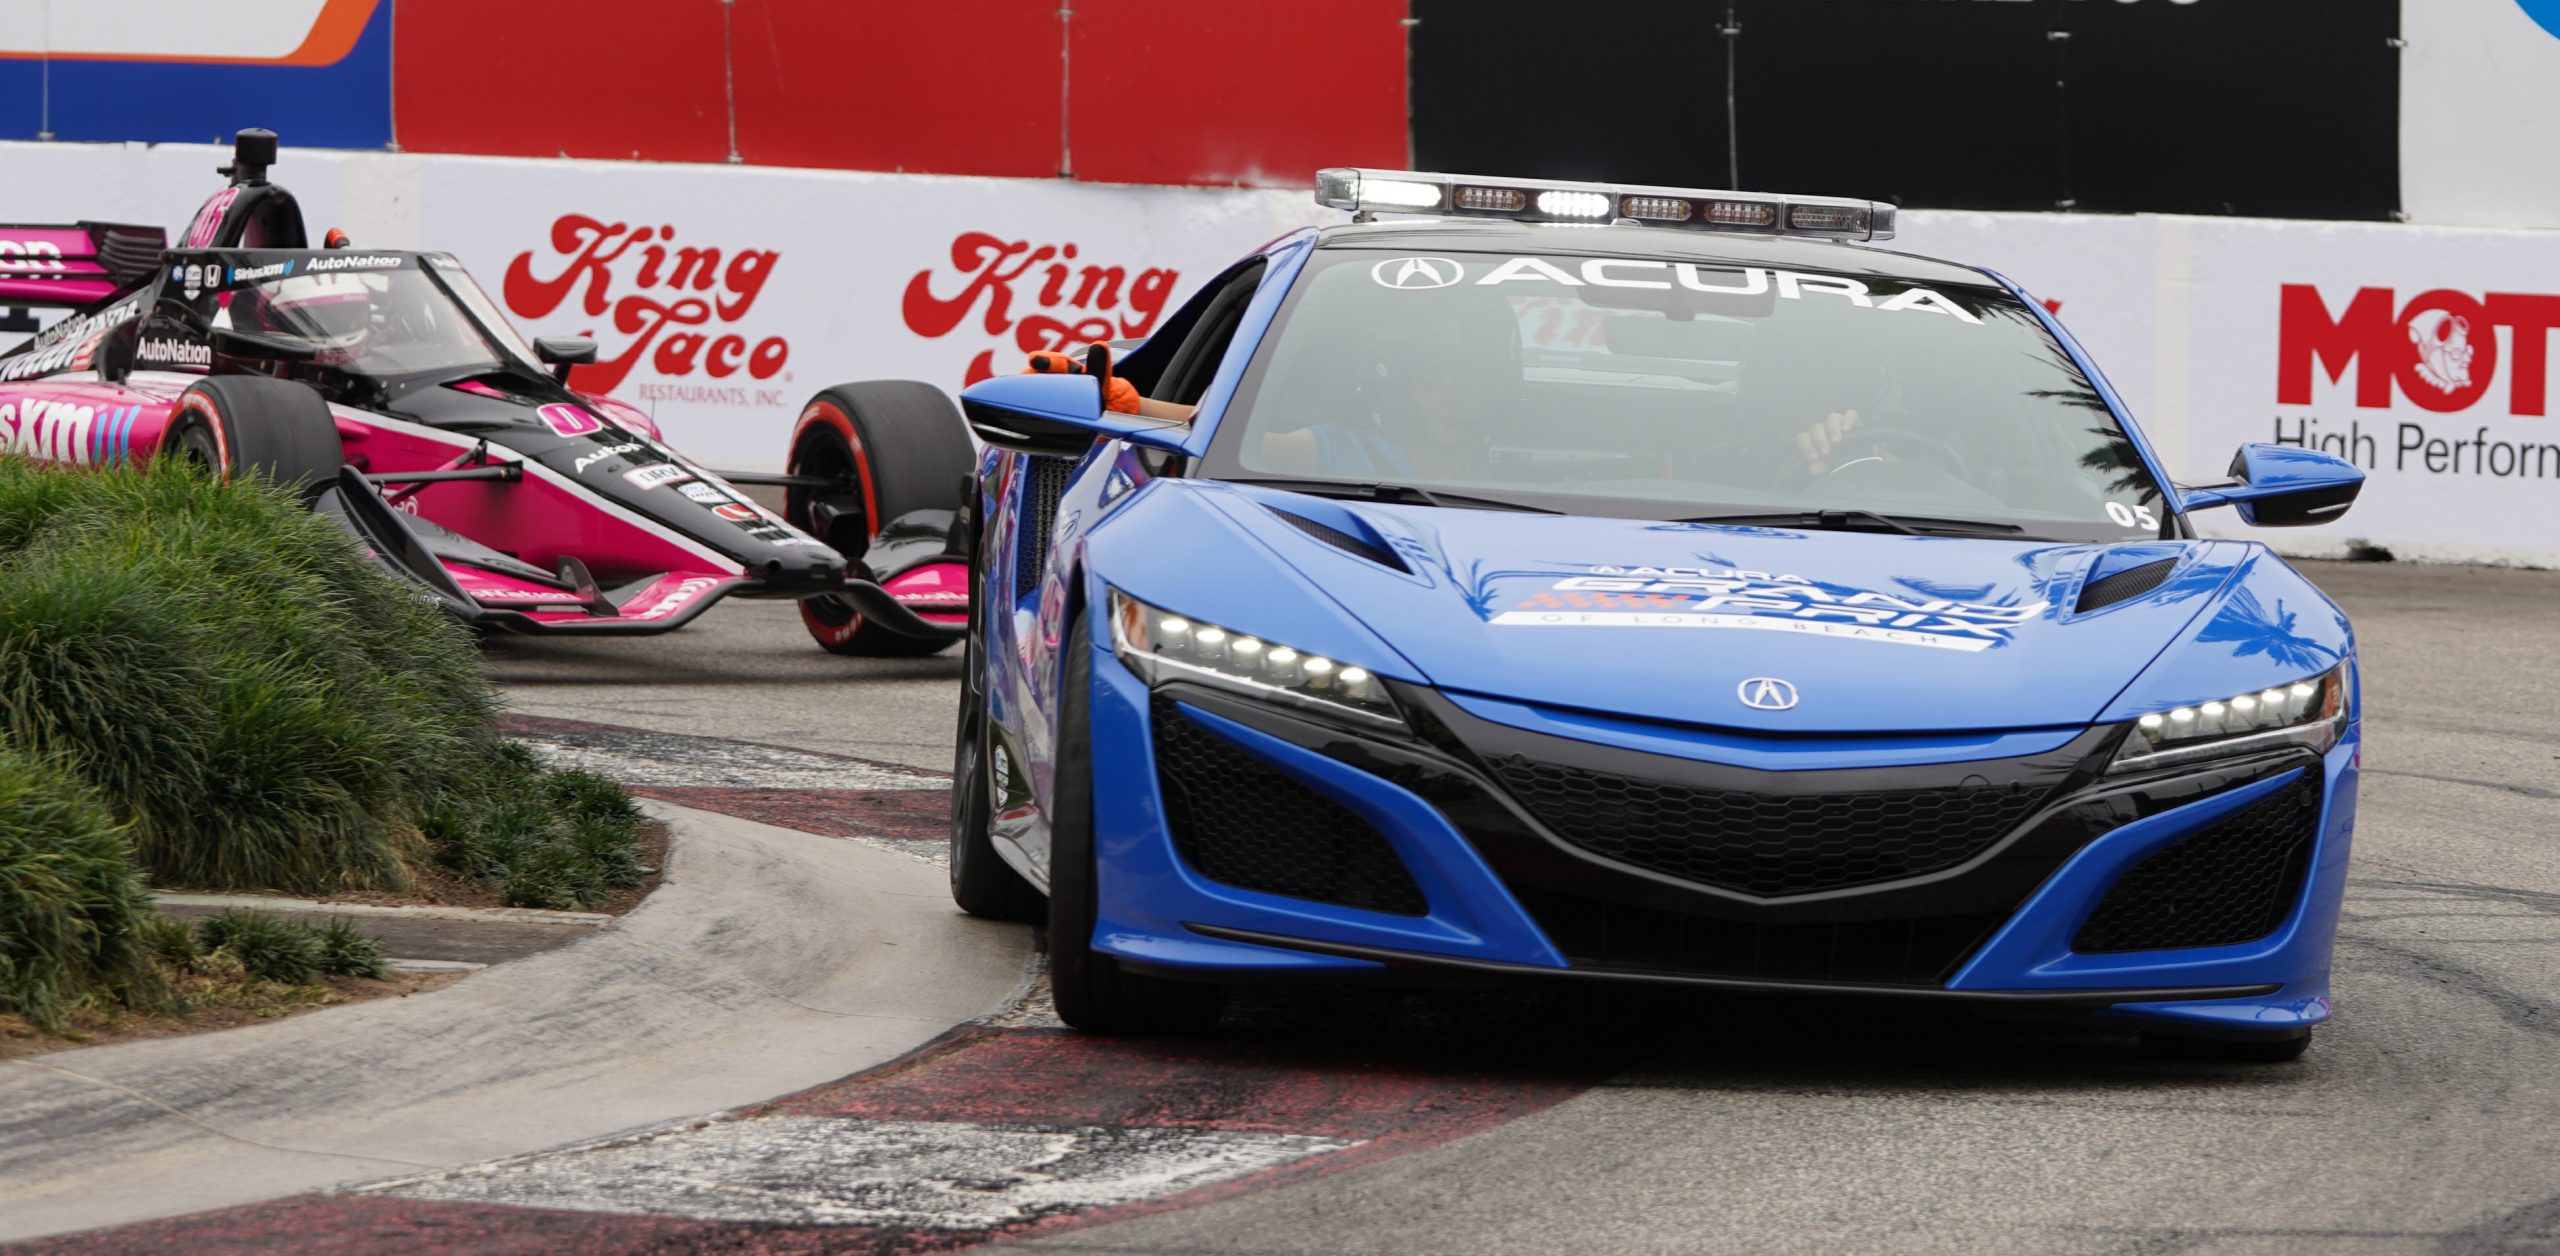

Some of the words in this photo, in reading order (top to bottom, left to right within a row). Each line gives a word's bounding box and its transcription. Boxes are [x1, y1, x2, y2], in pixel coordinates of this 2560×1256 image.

[306, 256, 402, 271] AutoNation
[503, 213, 781, 322] King
[902, 231, 1182, 339] King
[1475, 257, 1985, 325] ACURA
[136, 336, 212, 364] AutoNation
[566, 295, 789, 396] Taco
[2277, 283, 2560, 416] MOT
[2105, 502, 2160, 531] 05
[1627, 567, 1812, 584] ACURA
[1552, 576, 2050, 621] GRAND
[1691, 596, 2024, 639] PRIX
[1541, 613, 1597, 623] OF
[1634, 615, 1758, 627] LONG
[1793, 622, 1938, 645] BEACH
